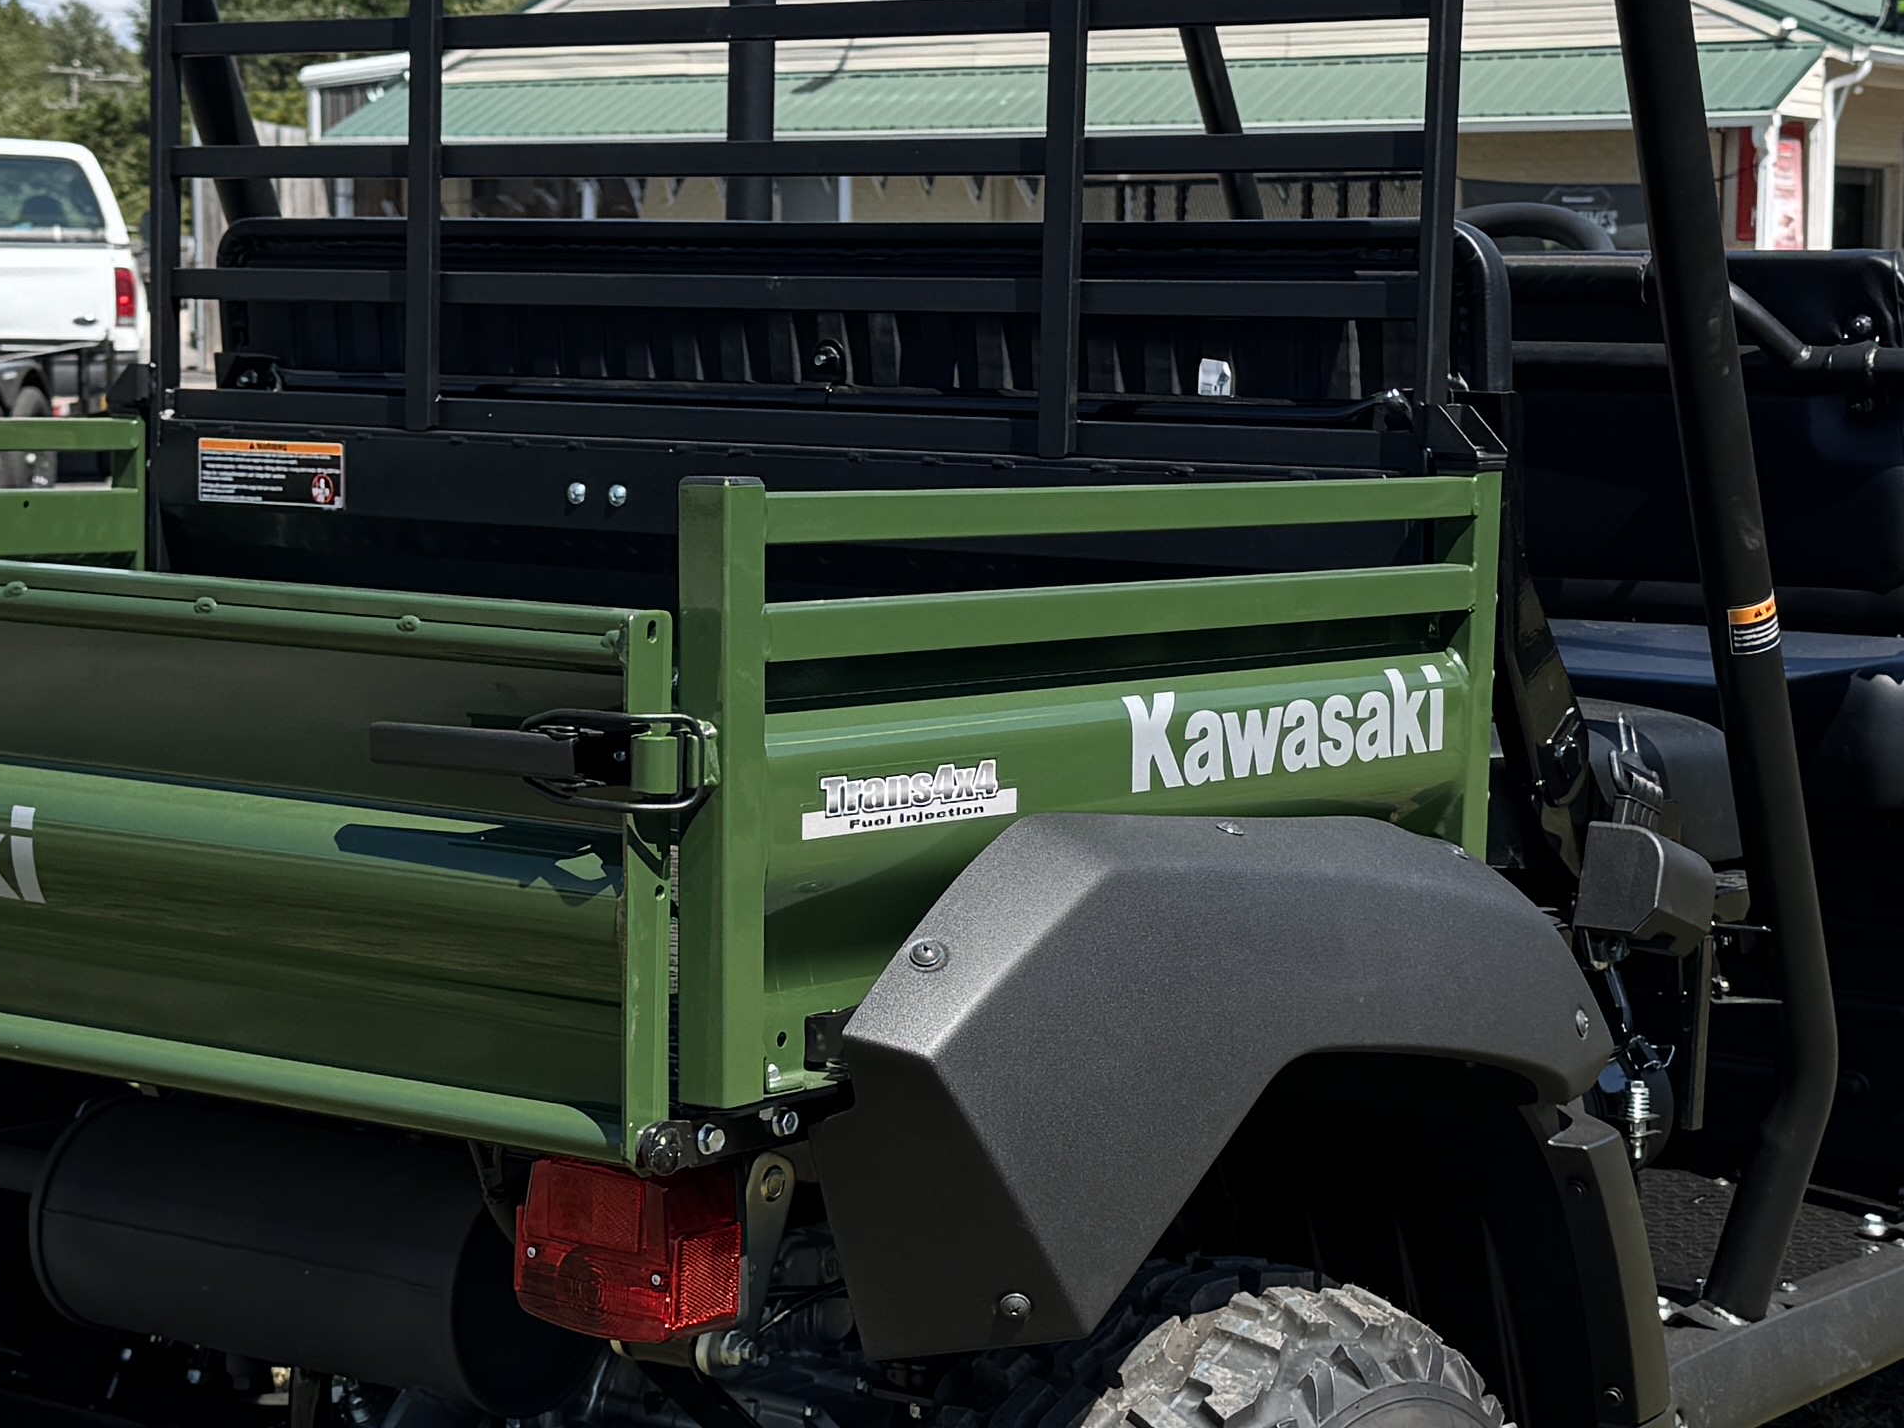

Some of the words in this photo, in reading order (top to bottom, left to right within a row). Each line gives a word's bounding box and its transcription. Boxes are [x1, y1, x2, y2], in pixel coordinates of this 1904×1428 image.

[1121, 663, 1446, 794] Kawasaki
[820, 758, 999, 818] Trans4x4
[849, 814, 892, 830] Fuel
[899, 805, 985, 823] Injection
